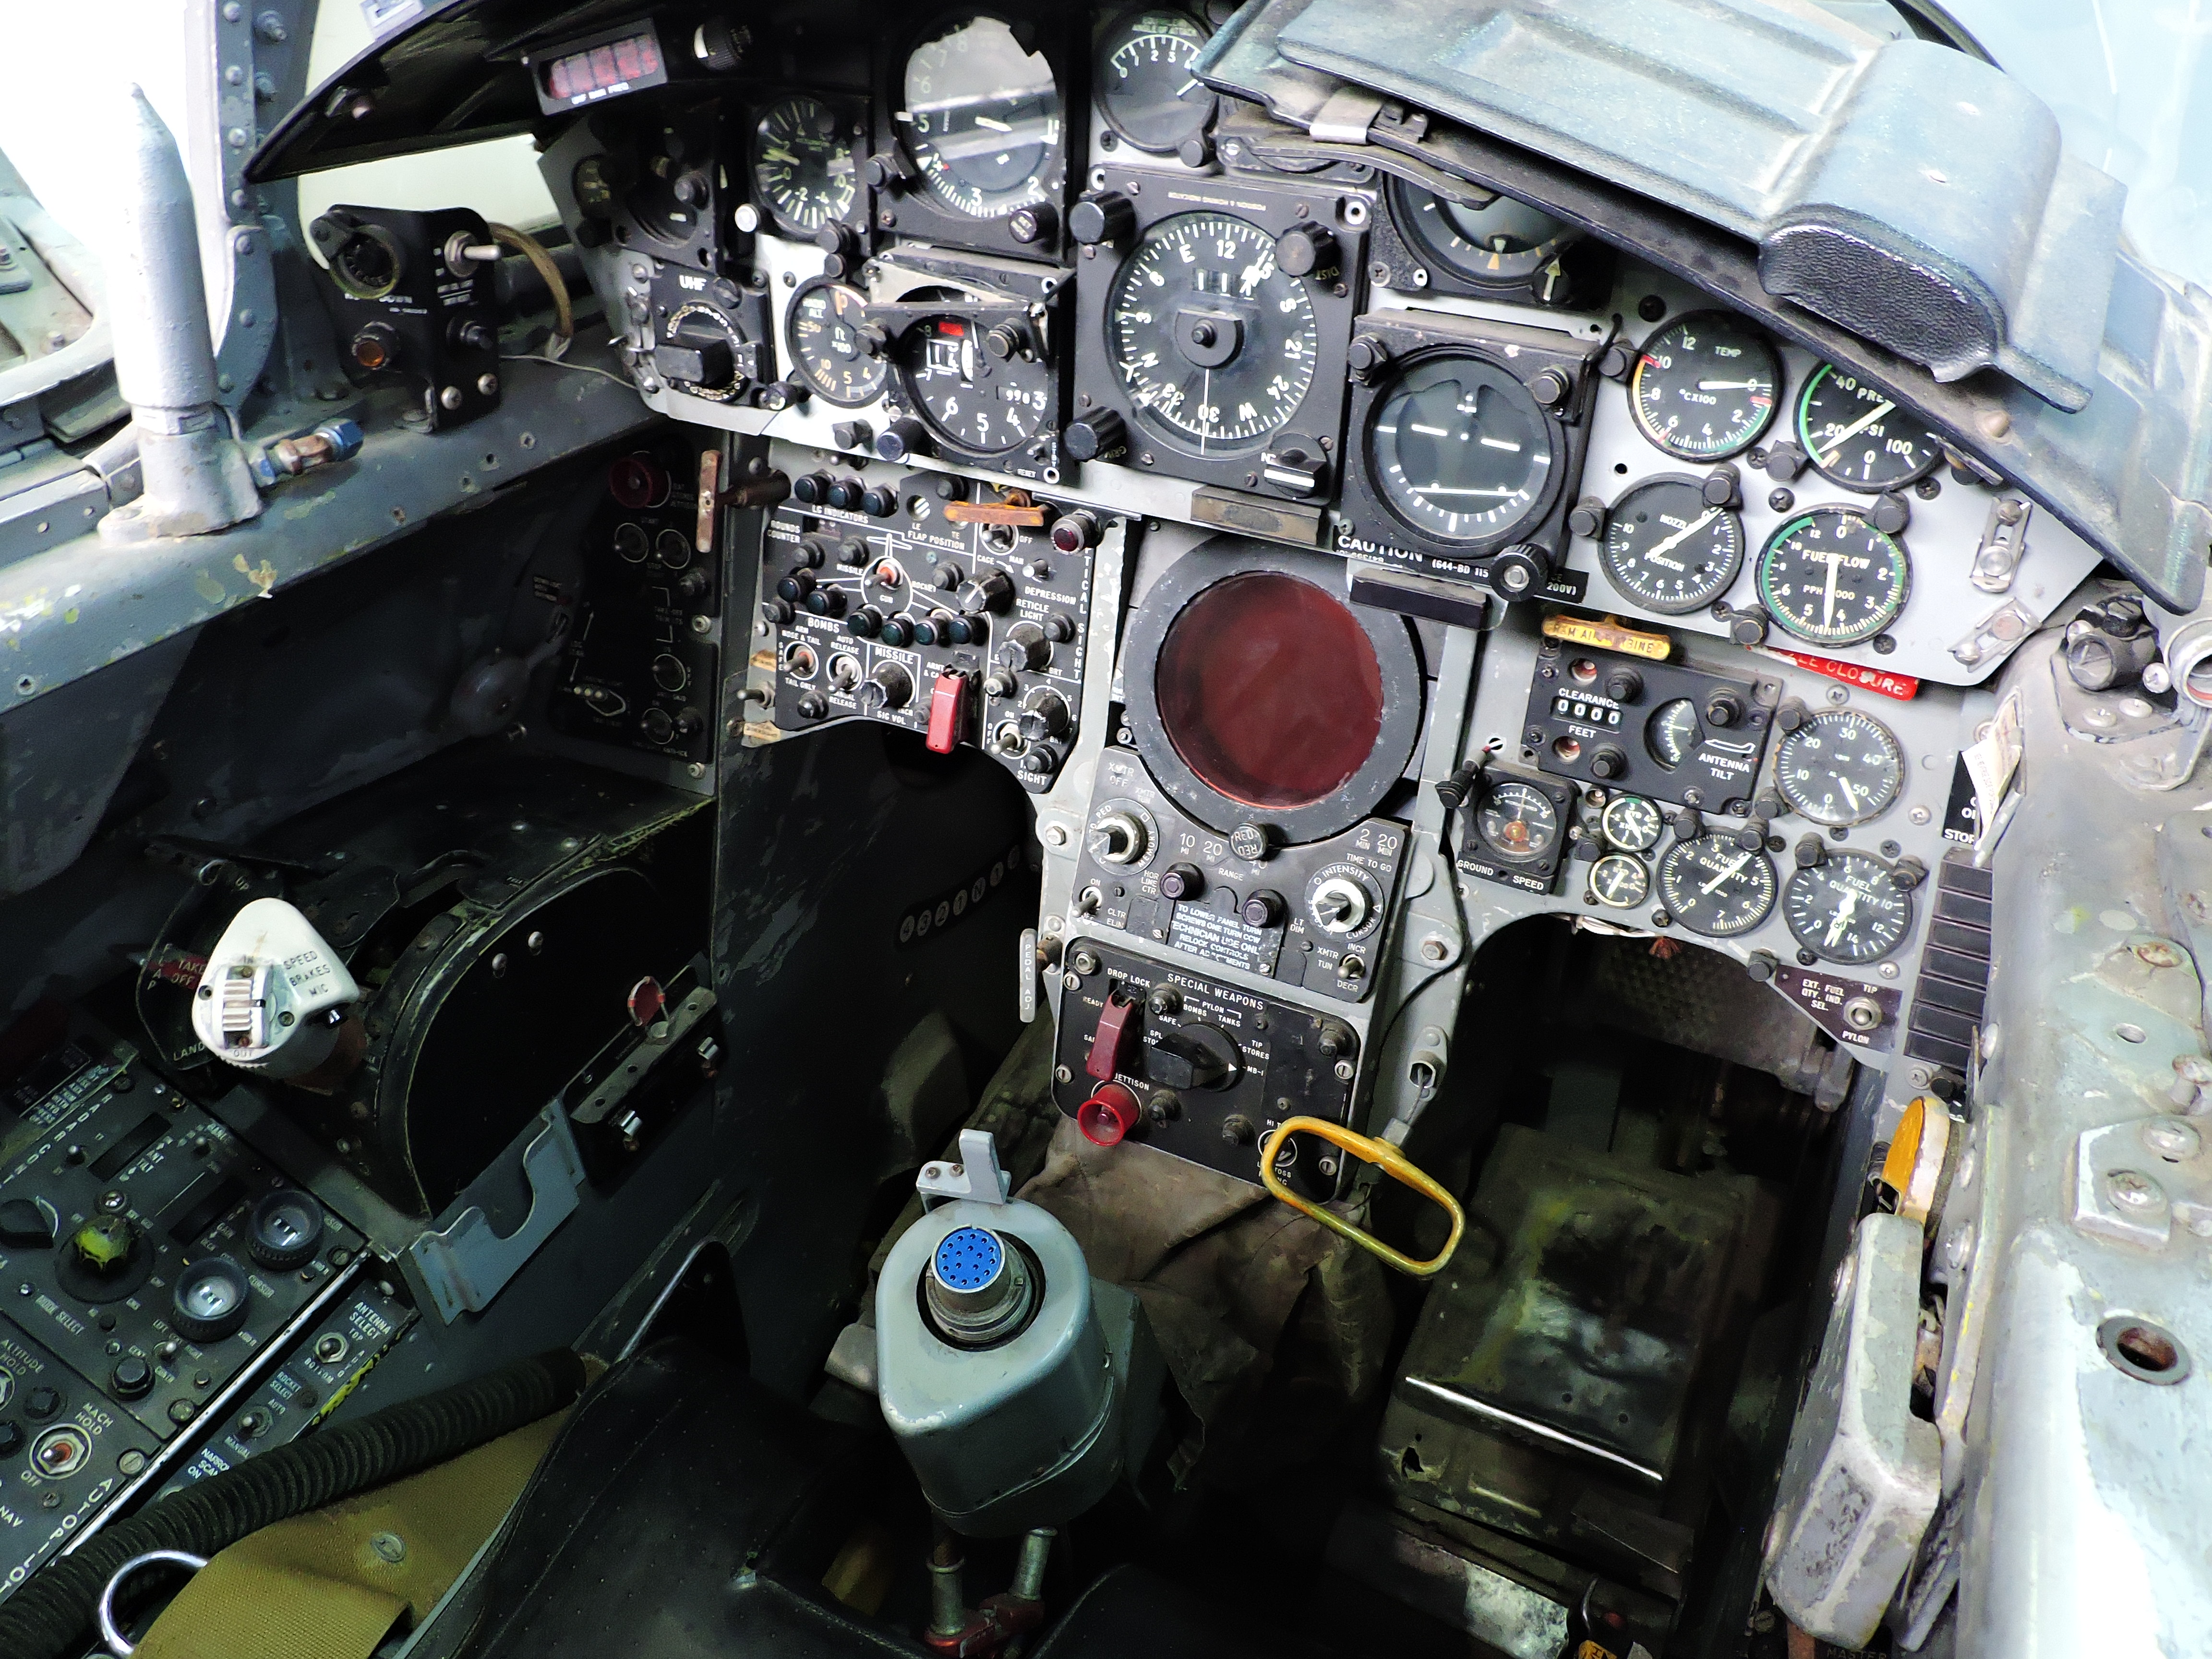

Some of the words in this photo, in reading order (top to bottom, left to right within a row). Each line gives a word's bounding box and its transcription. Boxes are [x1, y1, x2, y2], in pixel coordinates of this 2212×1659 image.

[917, 114, 929, 134] 5
[1027, 176, 1040, 195] 2
[971, 188, 983, 207] 3
[1179, 244, 1195, 264] E
[1216, 240, 1236, 260] 12
[679, 275, 707, 291] UHF
[1280, 298, 1297, 313] S
[1284, 338, 1303, 361] 21
[1683, 336, 1695, 350] 12
[1714, 345, 1742, 359] TEMP
[1141, 352, 1159, 368] N
[843, 371, 853, 385] 5
[1161, 383, 1186, 407] 33
[1266, 375, 1290, 401] 24
[945, 396, 959, 416] 6
[1032, 390, 1046, 411] 3
[1006, 407, 1021, 427] 4
[1238, 402, 1258, 421] W
[976, 412, 989, 433] 5
[1669, 415, 1679, 428] 6
[1702, 422, 1713, 436] 4
[1885, 438, 1913, 456] 100
[823, 506, 869, 524] INDICATORS
[912, 522, 921, 531] LE
[1809, 529, 1821, 539] 12
[907, 530, 927, 542] FLAP
[929, 534, 965, 551] POSITION
[951, 530, 961, 540] TE
[1020, 535, 1034, 544] OFF
[976, 554, 995, 565] CAGE
[1009, 555, 1024, 565] MAN
[1839, 555, 1871, 570] FLOW
[836, 564, 864, 576] MISSILE
[1024, 585, 1077, 606] DEPRESSION
[1015, 598, 1050, 613] RETICLE
[1020, 609, 1044, 622] LIGHT
[807, 617, 841, 634] BOMBS
[806, 636, 821, 646] TAIL
[837, 635, 854, 645] AUTO
[830, 641, 860, 655] RELEASE
[875, 646, 914, 664] MISSILE
[785, 677, 798, 686] TAIL
[829, 697, 857, 709] RELEASE
[1558, 687, 1620, 710] CLEARANCE
[877, 710, 890, 721] SIG
[891, 714, 907, 725] VOL
[1005, 710, 1015, 719] ON
[1568, 724, 1597, 739] FEET
[1839, 727, 1857, 740] 30
[1804, 737, 1822, 750] 20
[1698, 752, 1750, 774] ANTENNA
[1017, 770, 1047, 785] SIGHT
[1109, 776, 1128, 788] OFF
[1710, 768, 1735, 781] TILT
[1796, 769, 1810, 781] 10
[1852, 783, 1870, 797] 50
[1179, 833, 1196, 849] 10
[1233, 829, 1255, 841] RED
[1377, 833, 1398, 850] 20
[1138, 830, 1156, 868] MEMORY
[1202, 840, 1223, 856] 20
[1346, 852, 1365, 866] TIME
[1367, 858, 1378, 869] TO
[1379, 862, 1392, 873] GO
[1143, 869, 1160, 879] HOR
[1218, 867, 1244, 882] RANGE
[1322, 865, 1370, 882] INTENSITY
[1457, 859, 1494, 877] GROUND
[1513, 875, 1544, 891] SPEED
[1141, 877, 1158, 888] LINE
[1141, 885, 1157, 895] CTR
[1845, 875, 1872, 893] FUEL
[1881, 898, 1894, 911] 10
[1107, 907, 1127, 919] CLTR
[1178, 903, 1189, 913] TO
[1190, 907, 1216, 922] LOWER
[1216, 915, 1240, 929] PANEL
[1242, 923, 1263, 936] TURN
[1176, 912, 1207, 927] SCREWS
[1206, 922, 1223, 933] ONE
[1223, 927, 1243, 939] TURN
[1243, 933, 1262, 944] CCW
[1290, 925, 1305, 934] DIM
[1293, 917, 1305, 927] LT
[1346, 917, 1377, 940] CURSOR
[1872, 922, 1886, 934] 12
[1171, 920, 1220, 943] TECHNICIAN
[1221, 936, 1240, 950] USE
[1316, 946, 1339, 959] XMTR
[1347, 942, 1366, 954] INCR
[282, 950, 318, 971] SPEED
[1024, 944, 1032, 981] PEDAL
[1318, 959, 1334, 970] TUN
[289, 963, 331, 987] BRAKES
[1107, 967, 1128, 979] DROP
[1130, 974, 1151, 988] LOCK
[308, 983, 329, 997] MIC
[1167, 973, 1210, 995] SPECIAL
[1214, 987, 1264, 1010] WEAPONS
[1336, 980, 1358, 993] DECR
[1802, 979, 1821, 991] EXT.
[1824, 984, 1845, 997] FUEL
[1863, 984, 1878, 995] TIP
[1024, 988, 1033, 1010] ADJ
[1082, 996, 1104, 1008] READY
[1811, 999, 1829, 1011] SEL.
[1183, 1004, 1207, 1017] BOMBS
[1202, 1000, 1225, 1014] PYLON
[1159, 1015, 1178, 1026] SAFE
[1217, 1014, 1241, 1028] TANKS
[1150, 1029, 1163, 1039] SPL
[1842, 1030, 1870, 1045] PYLON
[1251, 1039, 1263, 1048] TIP
[172, 1042, 206, 1062] LAND
[1241, 1046, 1270, 1060] STORES
[1246, 1066, 1265, 1077] MB-1
[1114, 1071, 1150, 1091] JETTISON
[1266, 1118, 1274, 1127] HI
[55, 1310, 85, 1335] SELECT
[349, 1311, 382, 1340] SELECT
[354, 1301, 391, 1335] ANTENNA
[349, 1327, 364, 1341] TOP
[303, 1357, 335, 1384] BOTTOM
[276, 1371, 301, 1392] ROCKET
[269, 1379, 293, 1400] SELECT
[268, 1398, 287, 1415] AUTO
[83, 1402, 114, 1428] MACH
[74, 1412, 103, 1436] HOLD
[187, 1465, 202, 1480] ON
